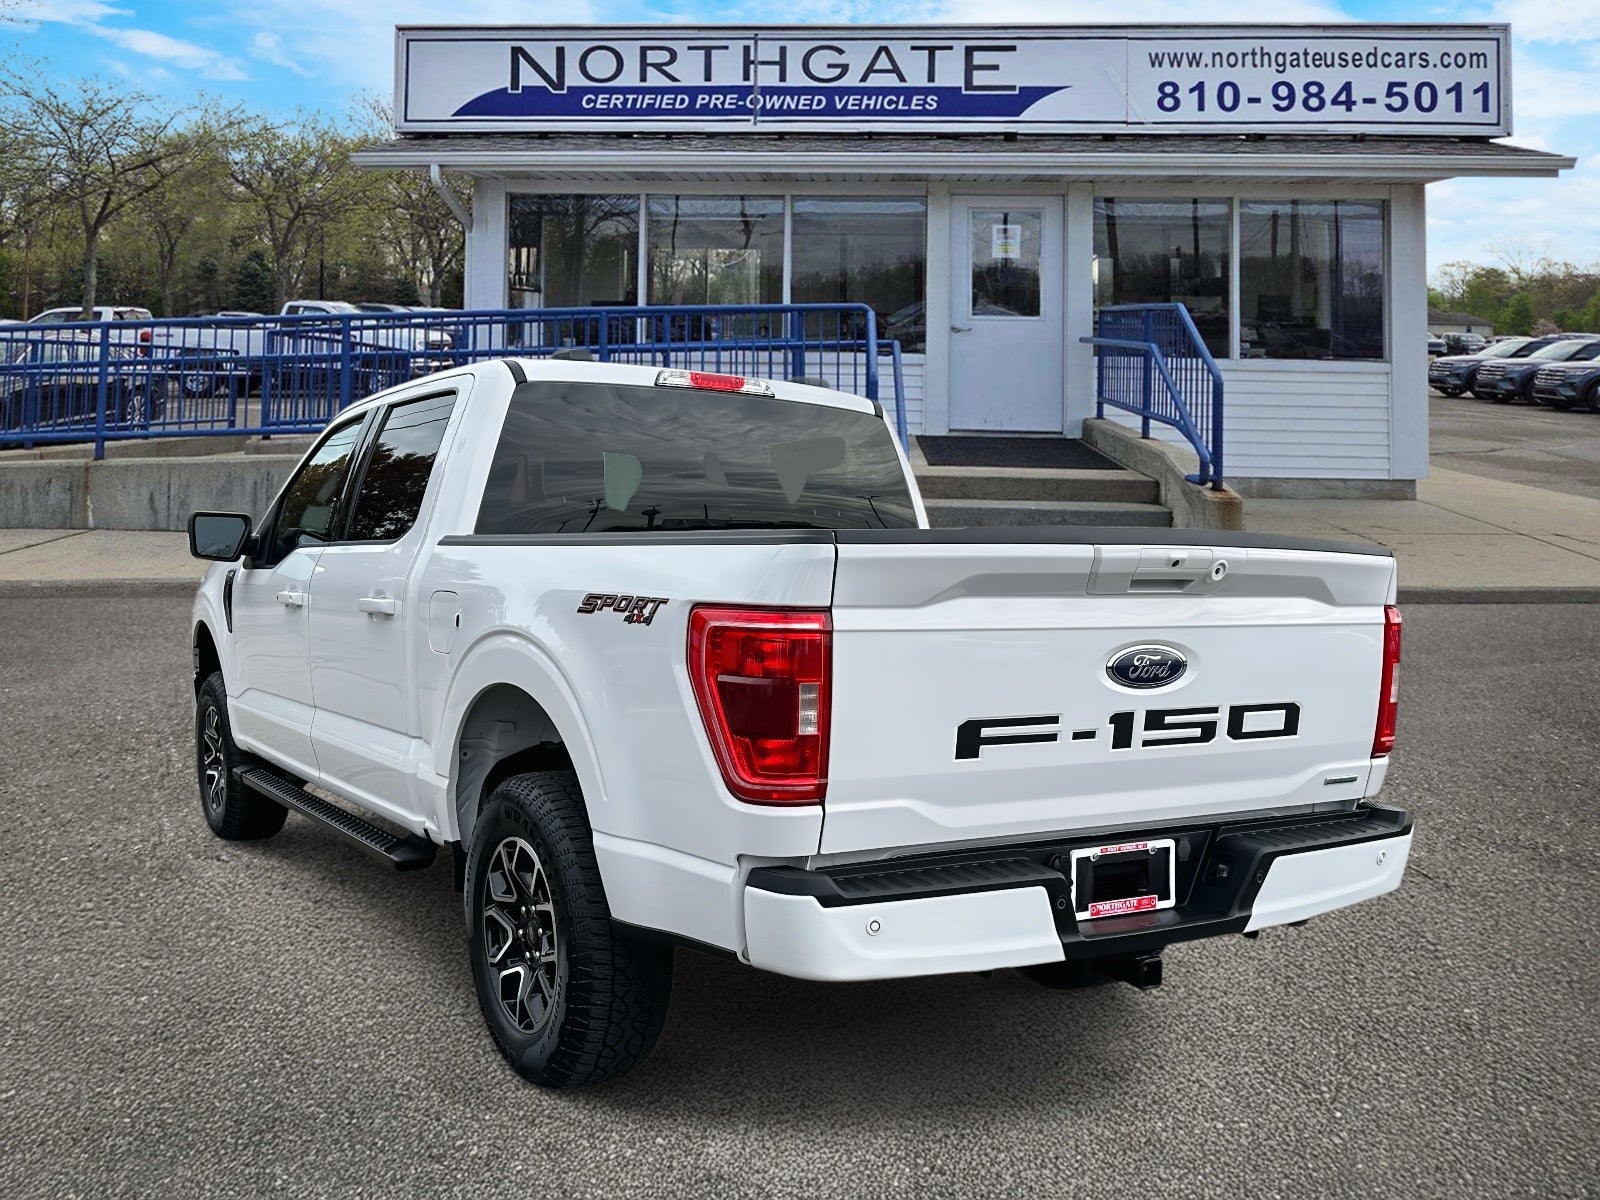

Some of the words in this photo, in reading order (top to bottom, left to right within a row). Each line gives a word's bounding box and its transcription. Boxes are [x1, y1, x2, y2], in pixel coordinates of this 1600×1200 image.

[508, 45, 1018, 93] NORTHGATE
[1148, 46, 1489, 73] www.northgateusedcars.com
[581, 94, 690, 110] CERTIFIED
[695, 94, 827, 110] PRE-OWNED
[834, 95, 939, 110] VEHICLES
[1156, 80, 1492, 114] 810-984-5011
[577, 593, 669, 614] SPORT
[1128, 654, 1172, 679] Ford
[954, 701, 1301, 761] F-150
[1096, 900, 1138, 911] NORTHGATE
